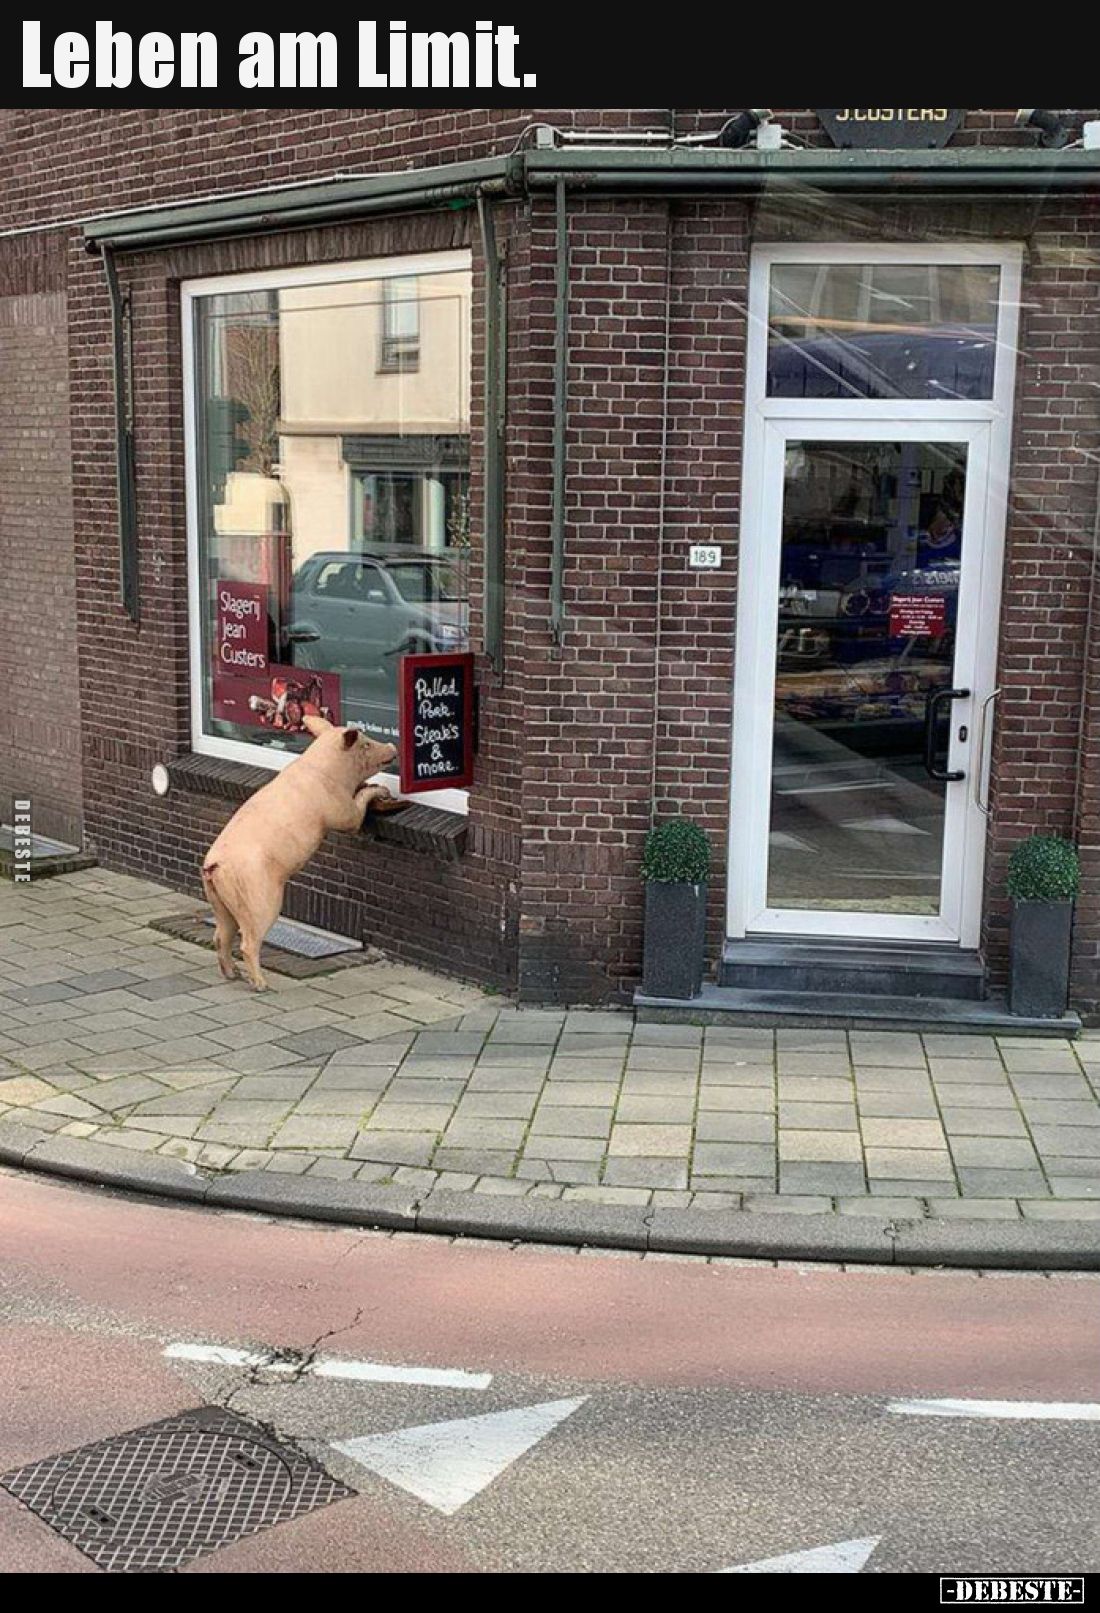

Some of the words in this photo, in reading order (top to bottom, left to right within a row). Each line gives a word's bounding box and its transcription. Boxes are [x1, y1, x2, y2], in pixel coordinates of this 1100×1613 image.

[694, 550, 716, 564] 189
[220, 591, 261, 621] Slagerij
[222, 617, 247, 641] Jean
[220, 643, 266, 668] Custers
[415, 677, 459, 700] Pulled
[431, 743, 443, 760] &
